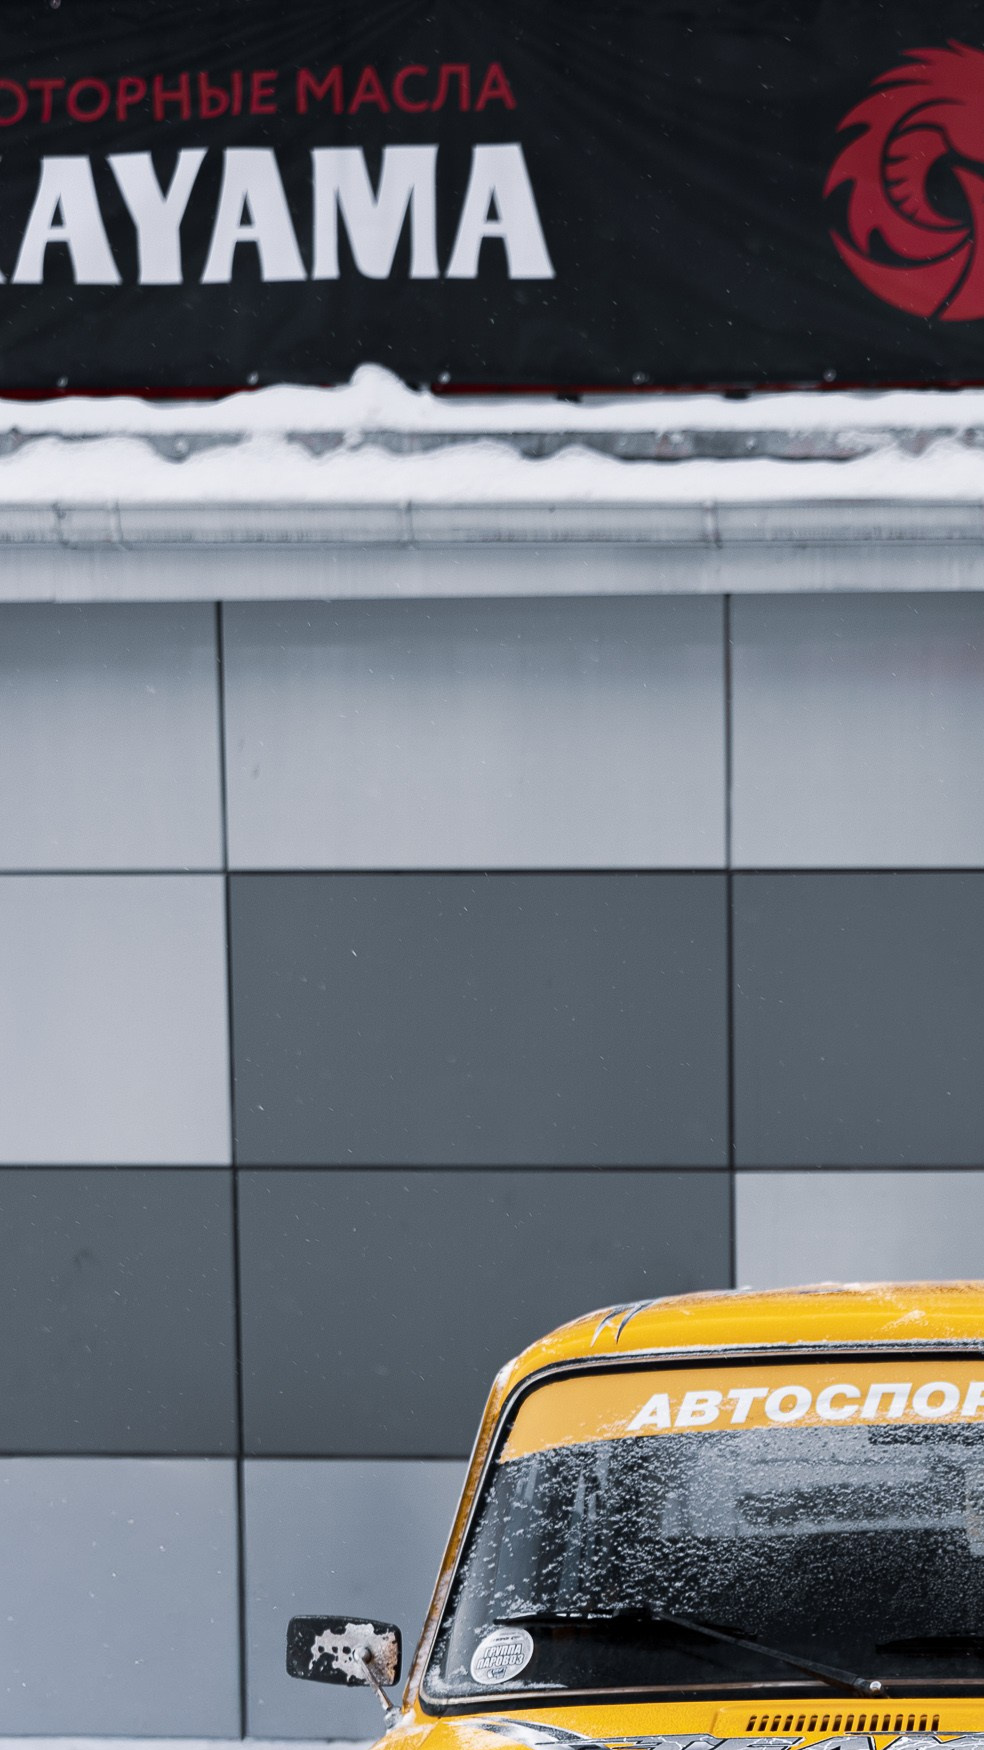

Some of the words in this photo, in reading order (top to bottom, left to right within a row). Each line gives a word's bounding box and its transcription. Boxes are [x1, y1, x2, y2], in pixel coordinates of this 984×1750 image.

[298, 62, 517, 115] МАСЛА
[0, 143, 555, 285] AYAMA
[477, 1654, 524, 1669] ПАРОВОЗ
[484, 1644, 522, 1657] ГРУППА
